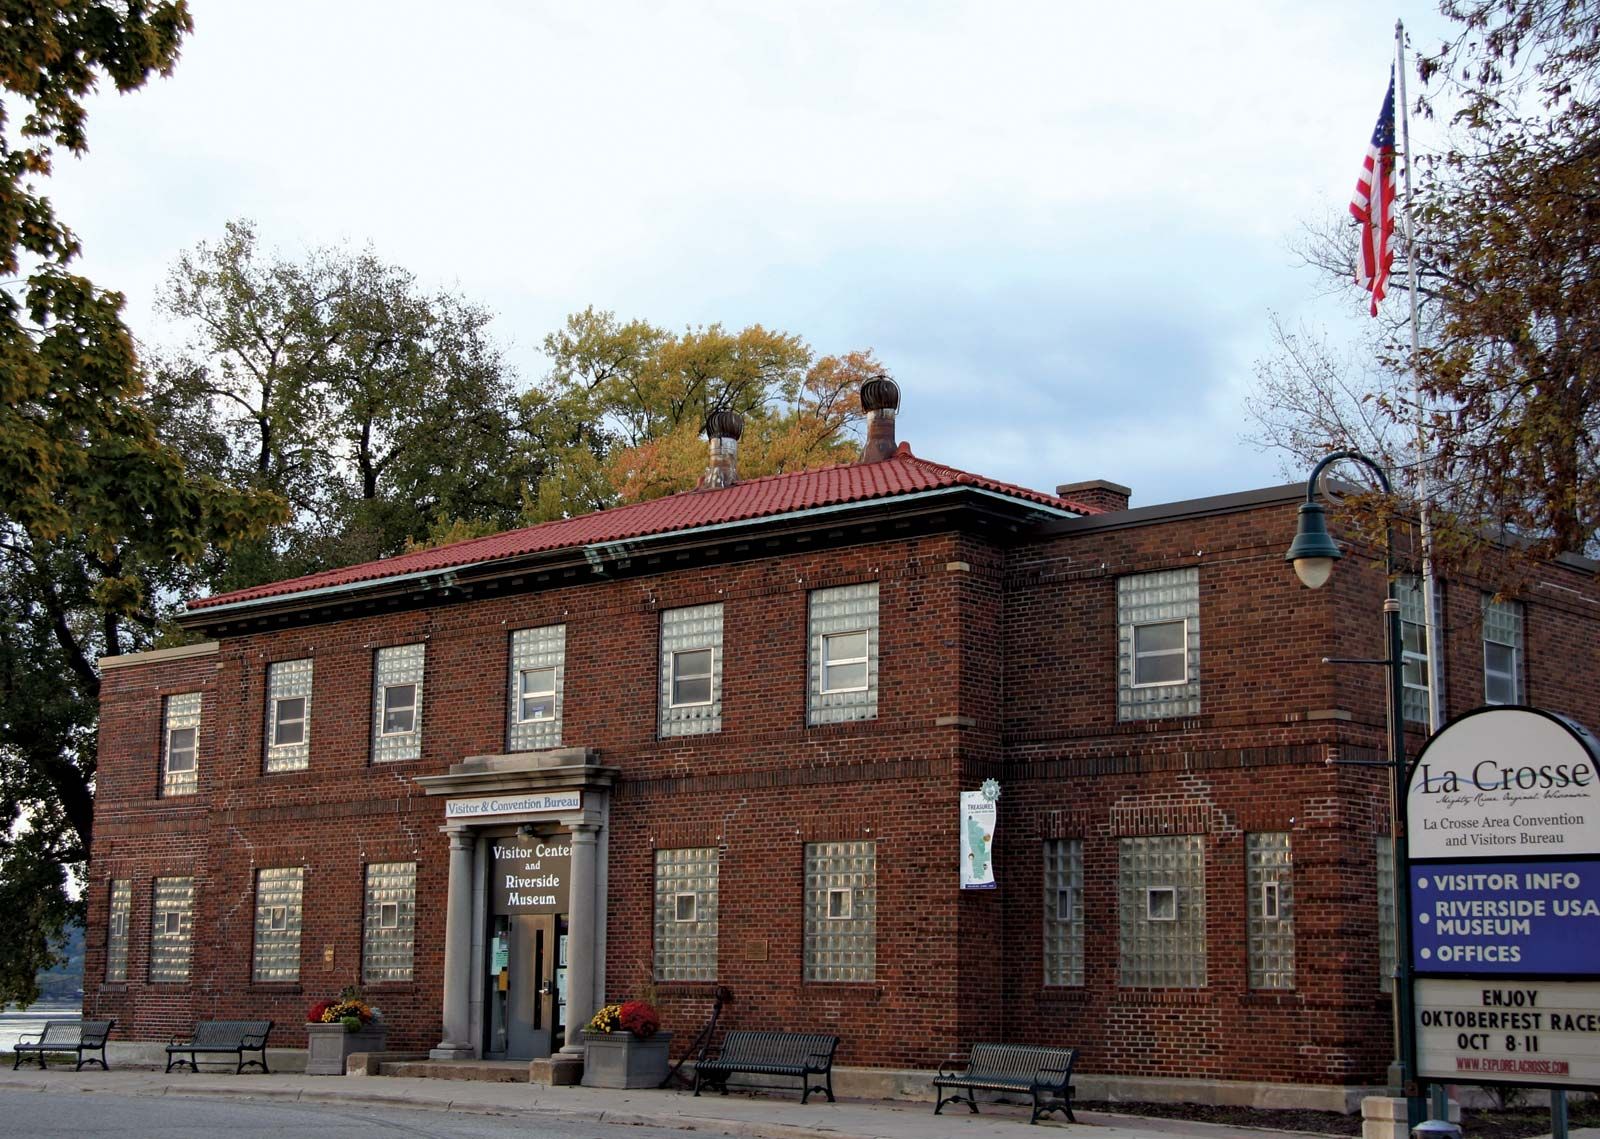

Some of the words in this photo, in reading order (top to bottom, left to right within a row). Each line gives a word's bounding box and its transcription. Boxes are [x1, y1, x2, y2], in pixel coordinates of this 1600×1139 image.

[1420, 764, 1459, 794] La
[1472, 760, 1590, 791] Crosse
[448, 803, 480, 815] Visitor
[481, 801, 489, 812] &
[490, 798, 542, 812] Convention
[544, 797, 579, 808] Bureau
[1423, 819, 1437, 830] La
[1440, 818, 1479, 829] Crosse
[1481, 817, 1510, 828] Area
[1512, 813, 1585, 826] Convention
[1445, 834, 1467, 846] and
[1470, 833, 1517, 845] Visitors
[1520, 832, 1564, 844] Bureau
[493, 846, 532, 859] Visitor
[525, 860, 541, 871] and
[505, 874, 560, 889] Riverside
[1433, 874, 1519, 891] VISITOR
[1525, 872, 1581, 890] INFO
[507, 892, 556, 906] Museum
[1435, 900, 1546, 917] RIVERSIDE
[1553, 900, 1600, 917] USA
[1436, 919, 1531, 936] MUSEUM
[1436, 945, 1521, 962] OFFICES
[1482, 989, 1538, 1007] ENJOY
[1420, 1010, 1542, 1030] OKTOBERFEST
[1457, 1033, 1490, 1050] OCT
[1456, 1057, 1569, 1075] WWW.EXPLORELACROSSE.COM
